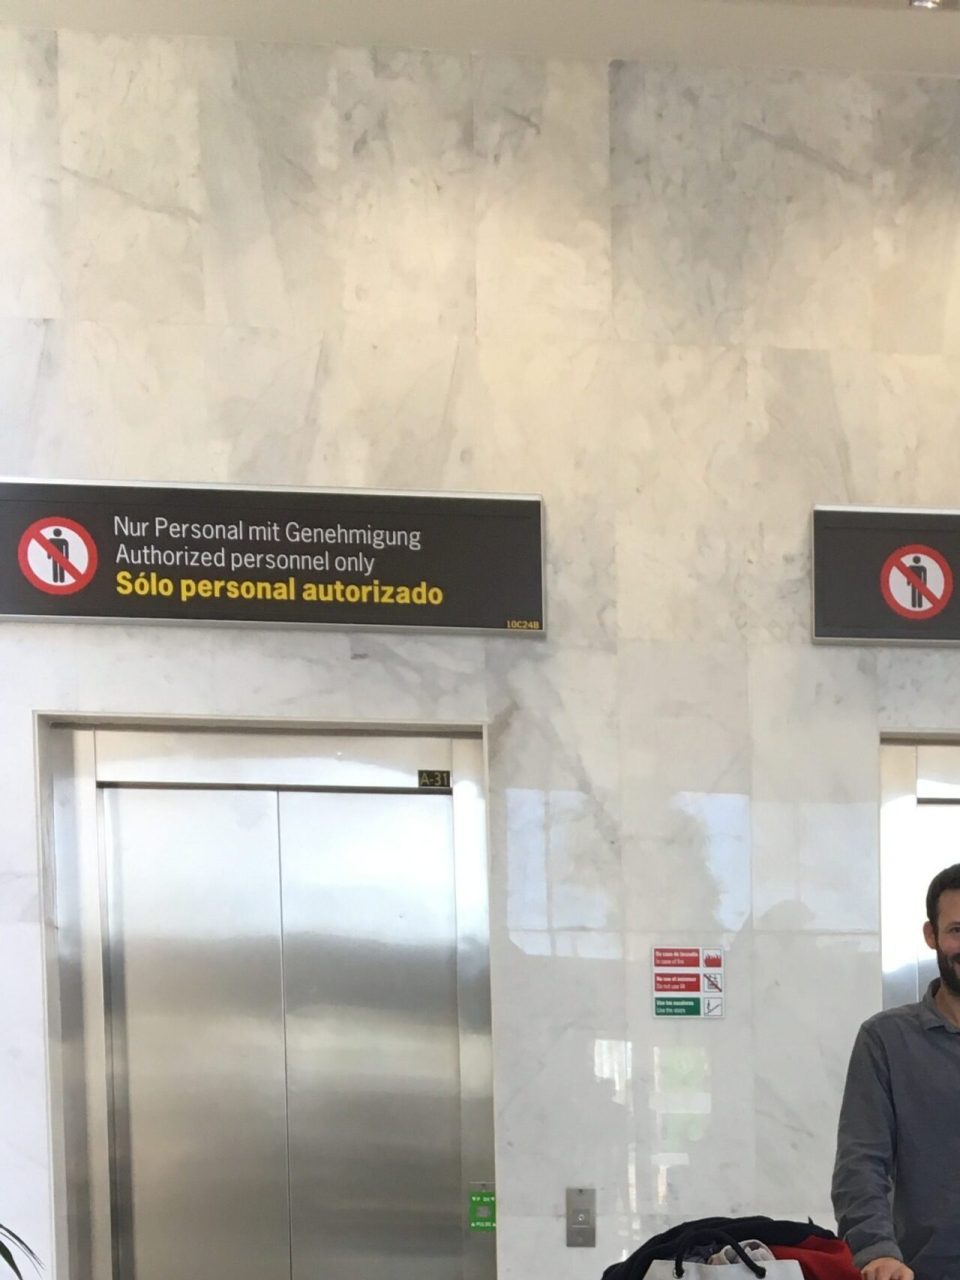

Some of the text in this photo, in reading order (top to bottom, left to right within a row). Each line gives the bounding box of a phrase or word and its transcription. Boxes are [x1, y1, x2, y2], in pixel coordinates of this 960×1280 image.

[114, 515, 421, 551] Nur Personal mit Genehmigung
[115, 543, 375, 576] Authorized personnel only
[116, 570, 444, 605] Sólo personal autorizado
[420, 771, 448, 786] A-31
